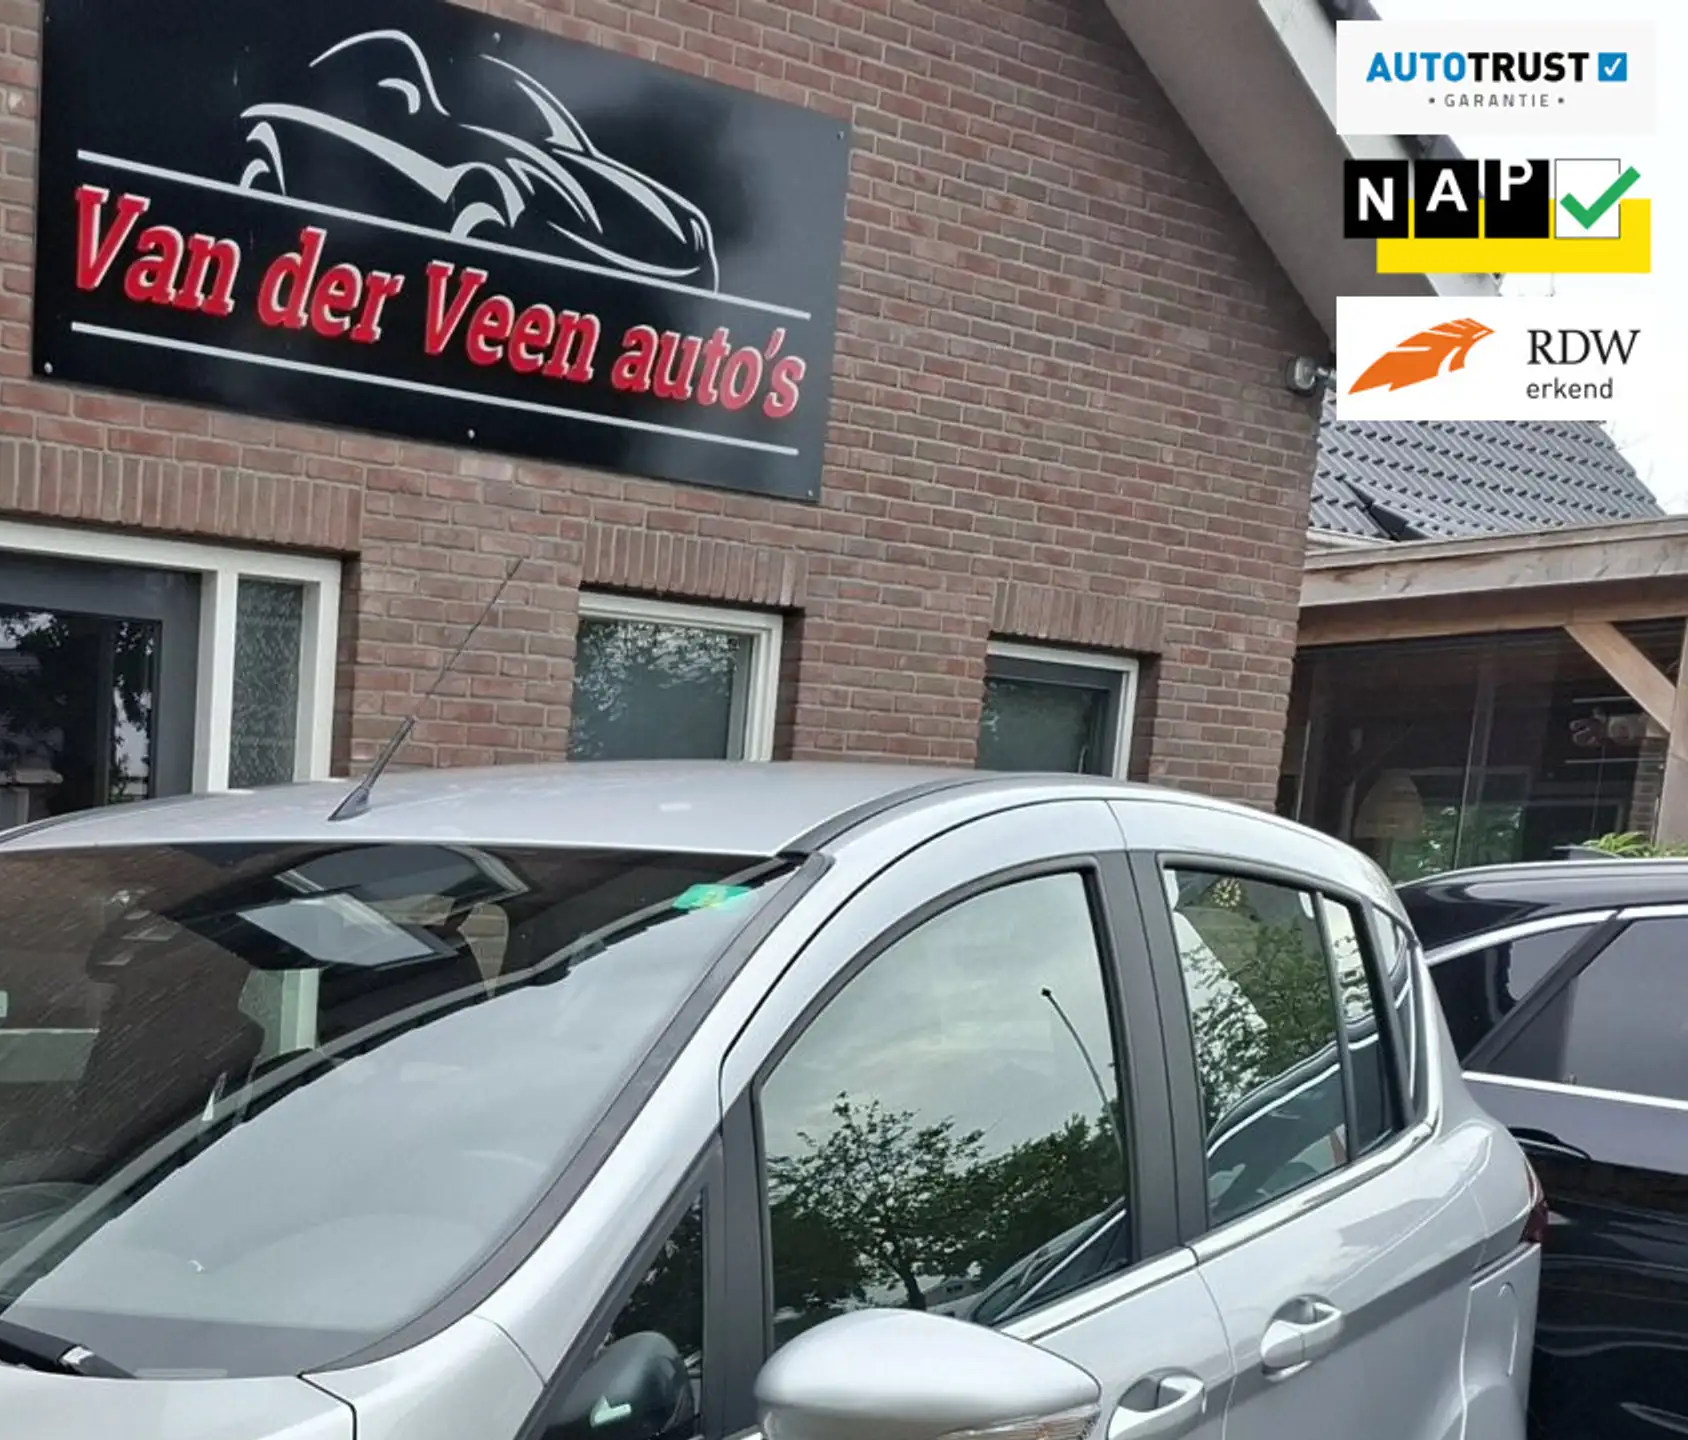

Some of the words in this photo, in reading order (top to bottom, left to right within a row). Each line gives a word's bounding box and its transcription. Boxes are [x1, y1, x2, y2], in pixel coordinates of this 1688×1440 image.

[75, 184, 242, 316] Van
[257, 226, 405, 343] der
[424, 260, 601, 383] Veen
[612, 325, 807, 419] auto's
